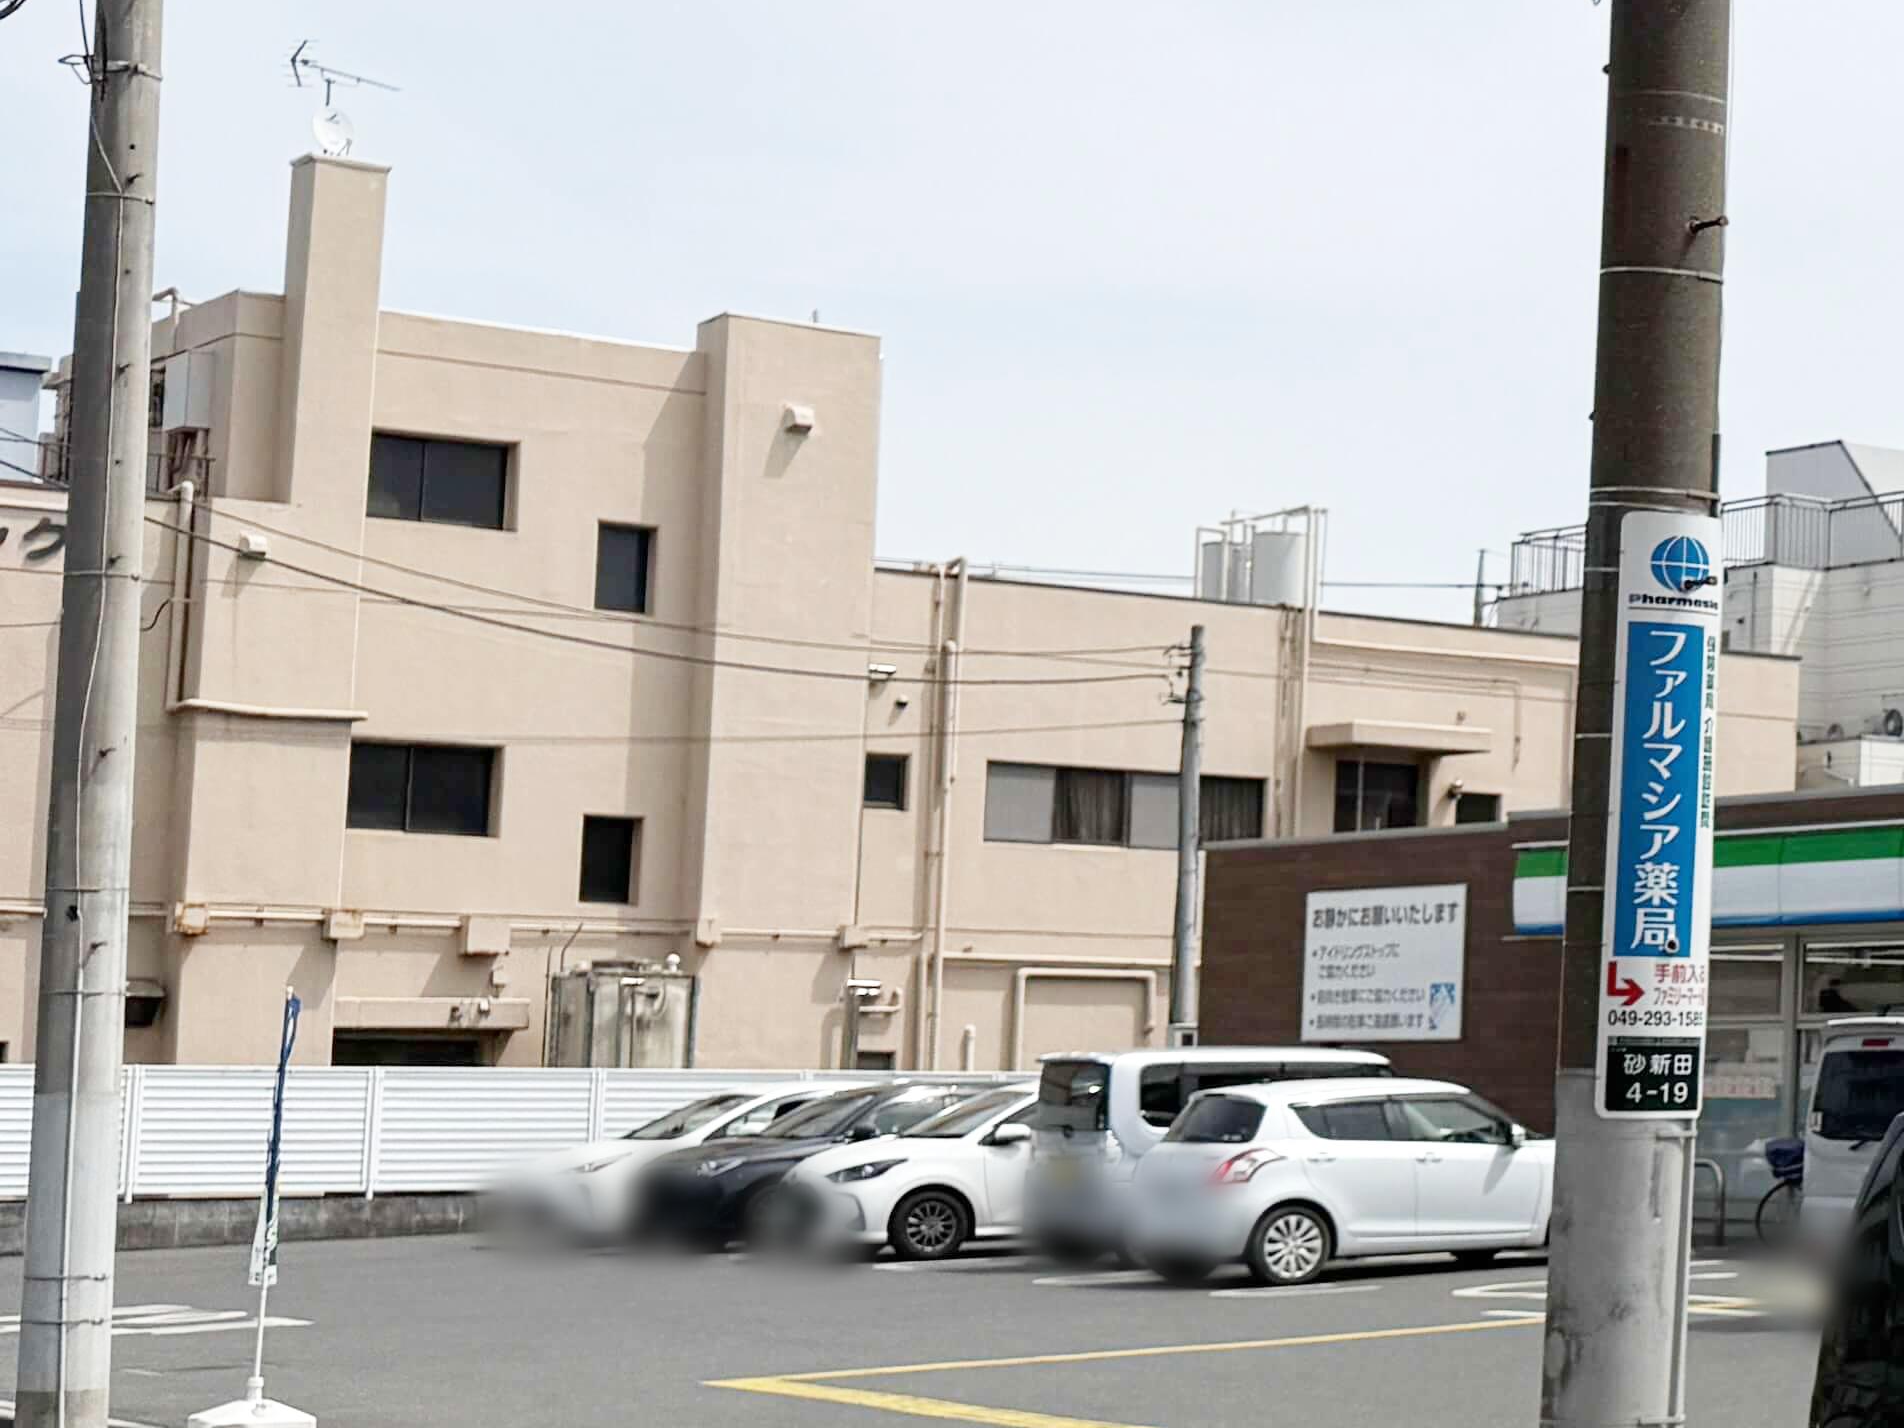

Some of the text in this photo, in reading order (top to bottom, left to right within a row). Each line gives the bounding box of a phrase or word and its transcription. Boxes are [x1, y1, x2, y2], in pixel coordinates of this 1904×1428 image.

[1630, 630, 1688, 951] ファルマシア薬局
[1623, 1053, 1693, 1076] 砂新田
[1625, 1081, 1689, 1105] 4-19
